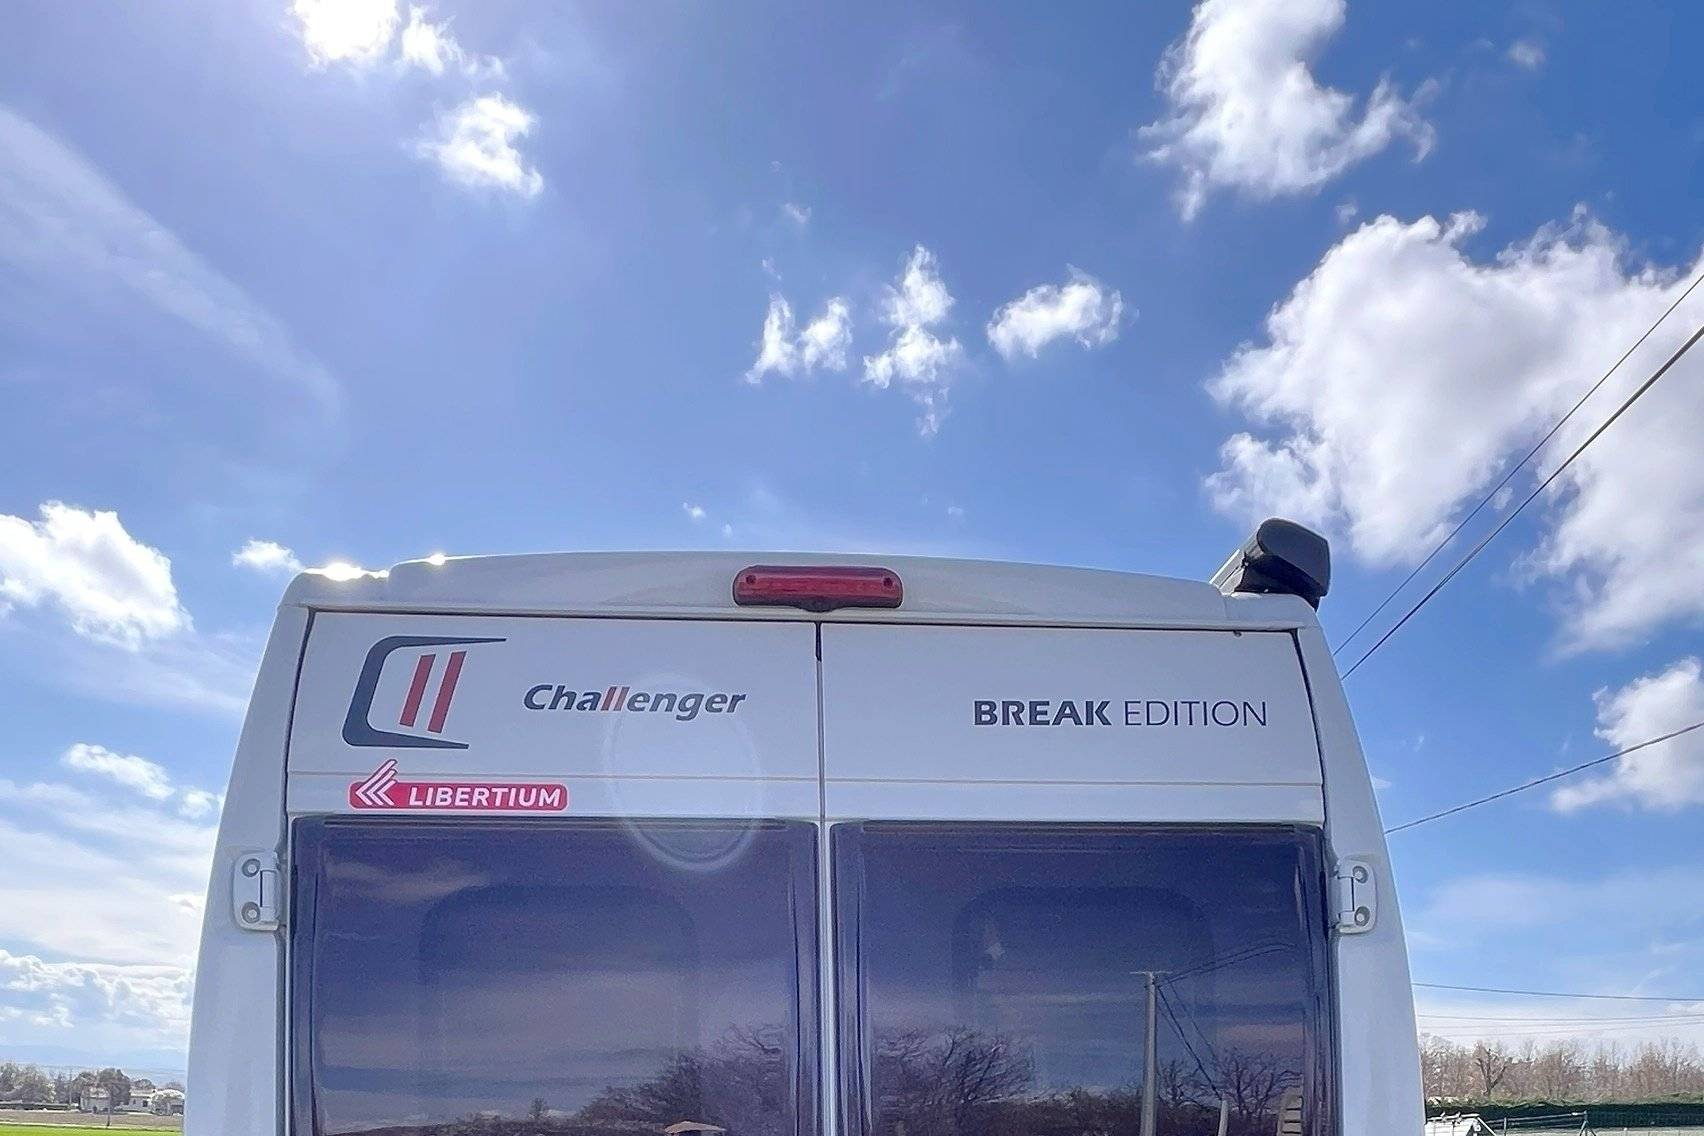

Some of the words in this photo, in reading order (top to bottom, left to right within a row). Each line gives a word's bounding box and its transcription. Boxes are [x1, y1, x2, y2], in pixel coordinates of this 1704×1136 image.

[523, 684, 746, 721] Challenger
[973, 700, 1112, 726] BREAK
[1124, 701, 1267, 726] EDITION
[408, 786, 561, 807] LIBERTIUM
